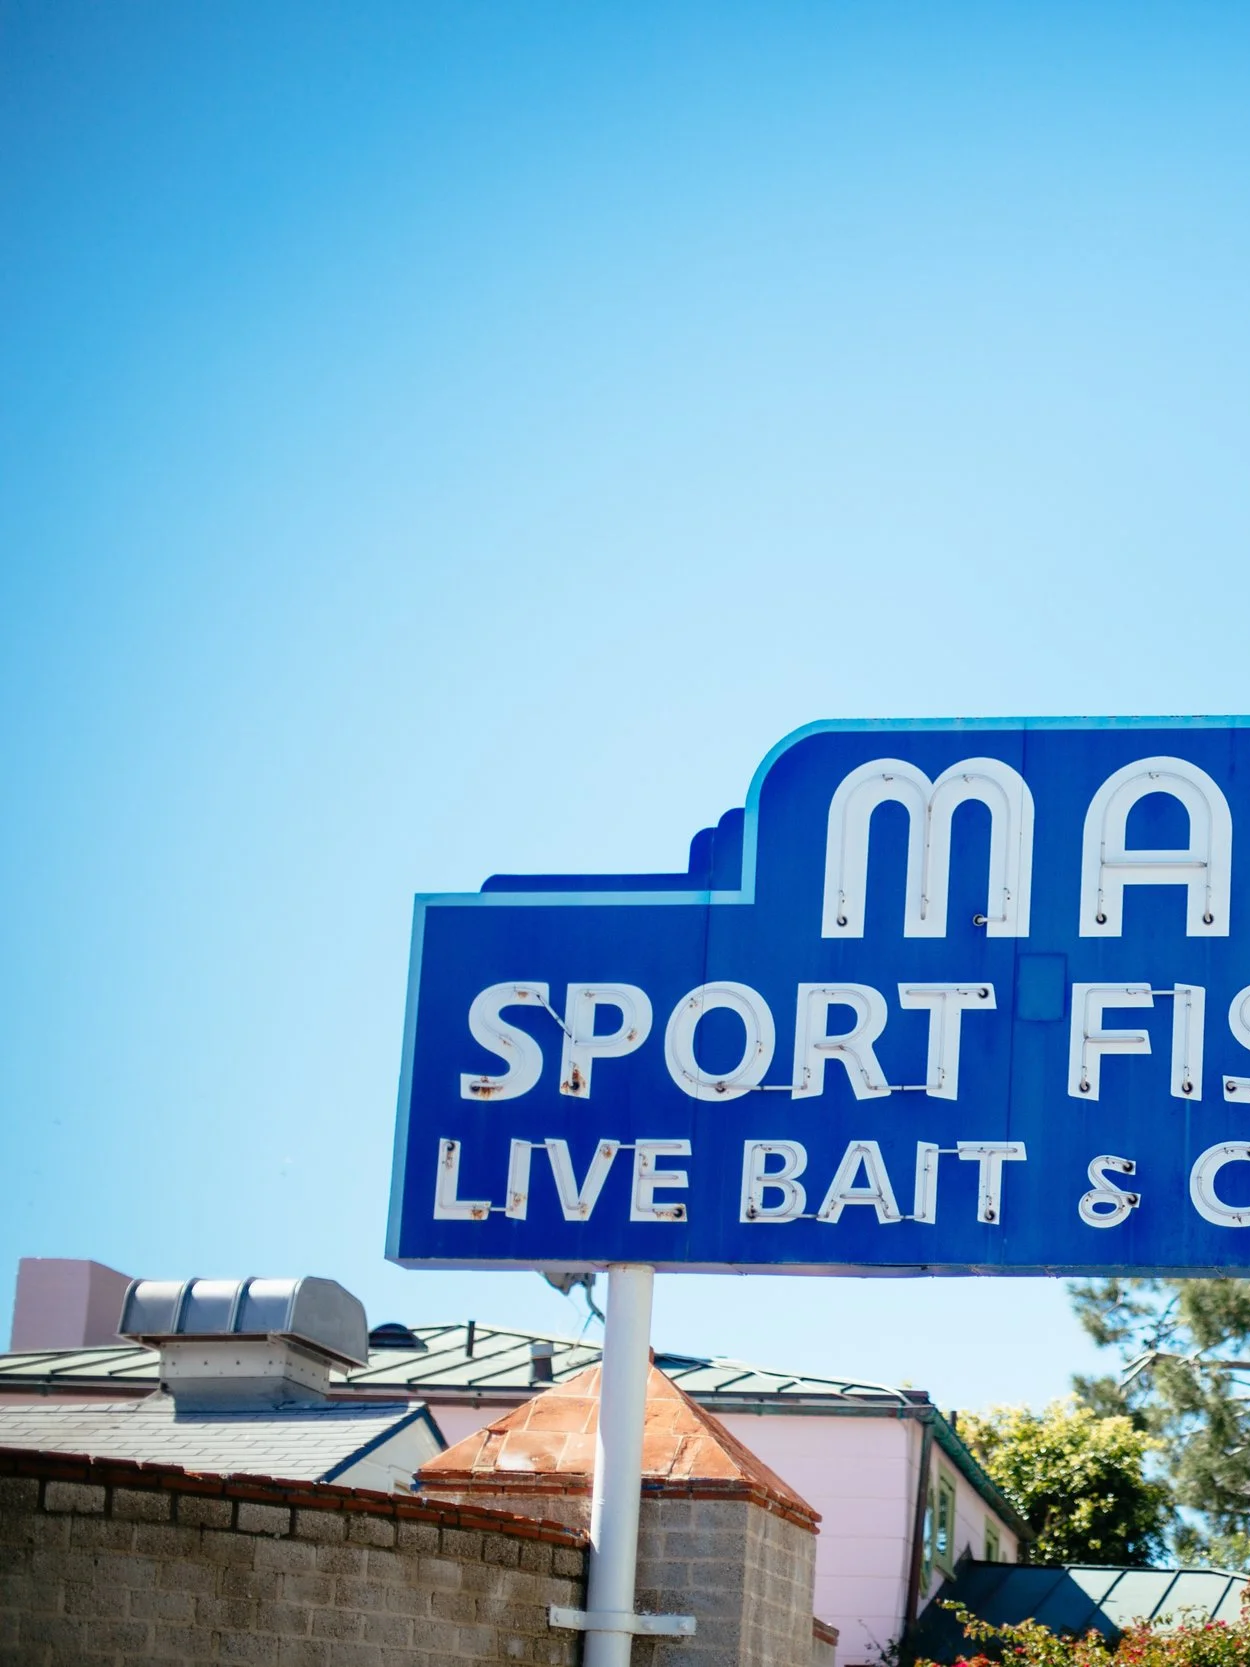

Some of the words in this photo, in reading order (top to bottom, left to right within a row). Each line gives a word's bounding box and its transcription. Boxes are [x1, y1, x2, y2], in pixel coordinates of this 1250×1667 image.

[460, 981, 997, 1101] SPORT
[433, 1138, 692, 1222] LIVE
[739, 1140, 1027, 1225] BAIT
[1078, 1155, 1141, 1228] &
